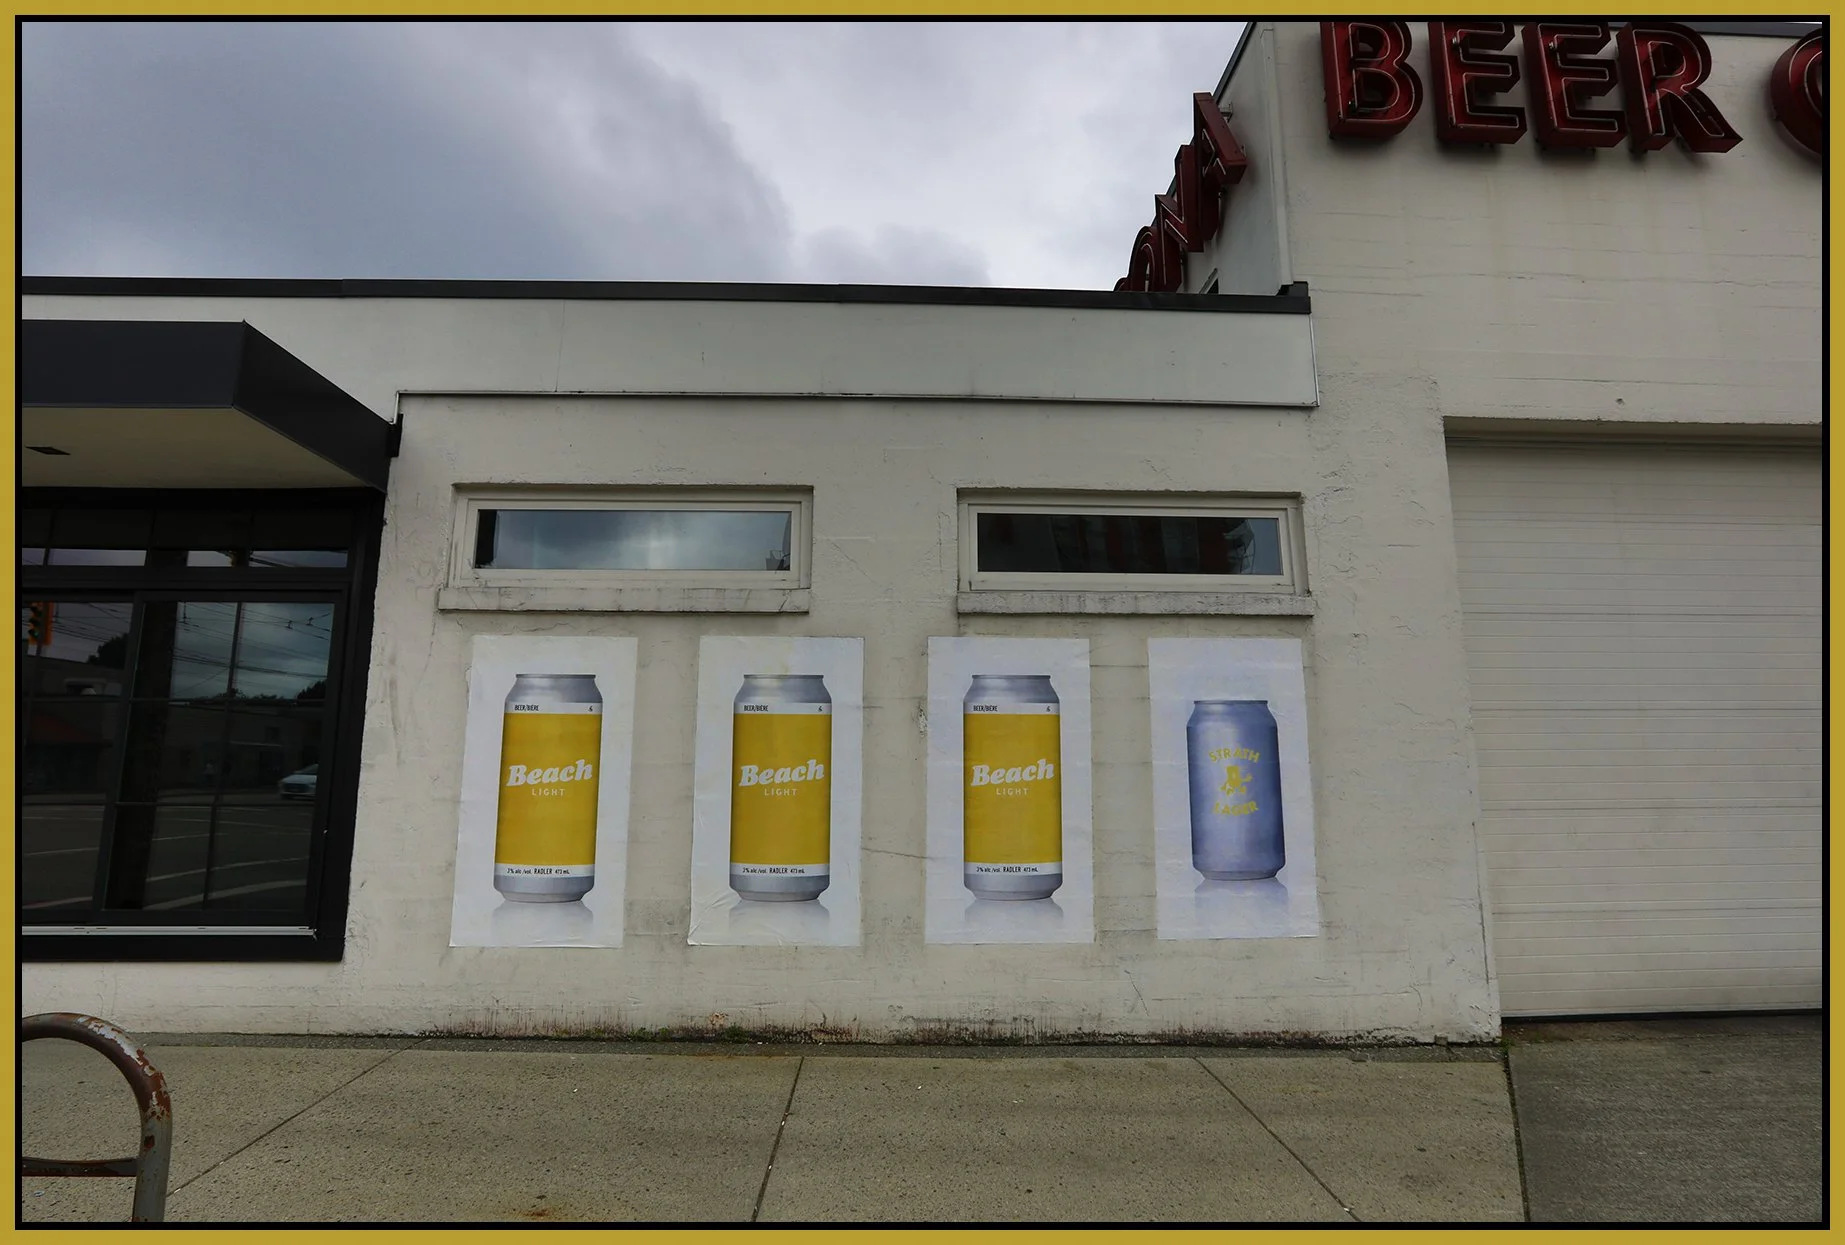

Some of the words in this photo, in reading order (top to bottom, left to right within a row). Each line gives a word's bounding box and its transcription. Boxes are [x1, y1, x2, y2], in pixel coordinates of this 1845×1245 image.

[1320, 21, 1744, 154] BEER
[1113, 92, 1248, 293] ONA
[1208, 747, 1260, 763] STRATH
[505, 758, 593, 787] Beach
[738, 758, 825, 787] Beach
[970, 758, 1054, 787] Beach
[531, 788, 565, 796] LIGHT
[764, 788, 797, 796] LIGHT
[996, 788, 1029, 796] LIGHT
[1212, 800, 1259, 816] LAGER
[533, 867, 553, 875] RADLER
